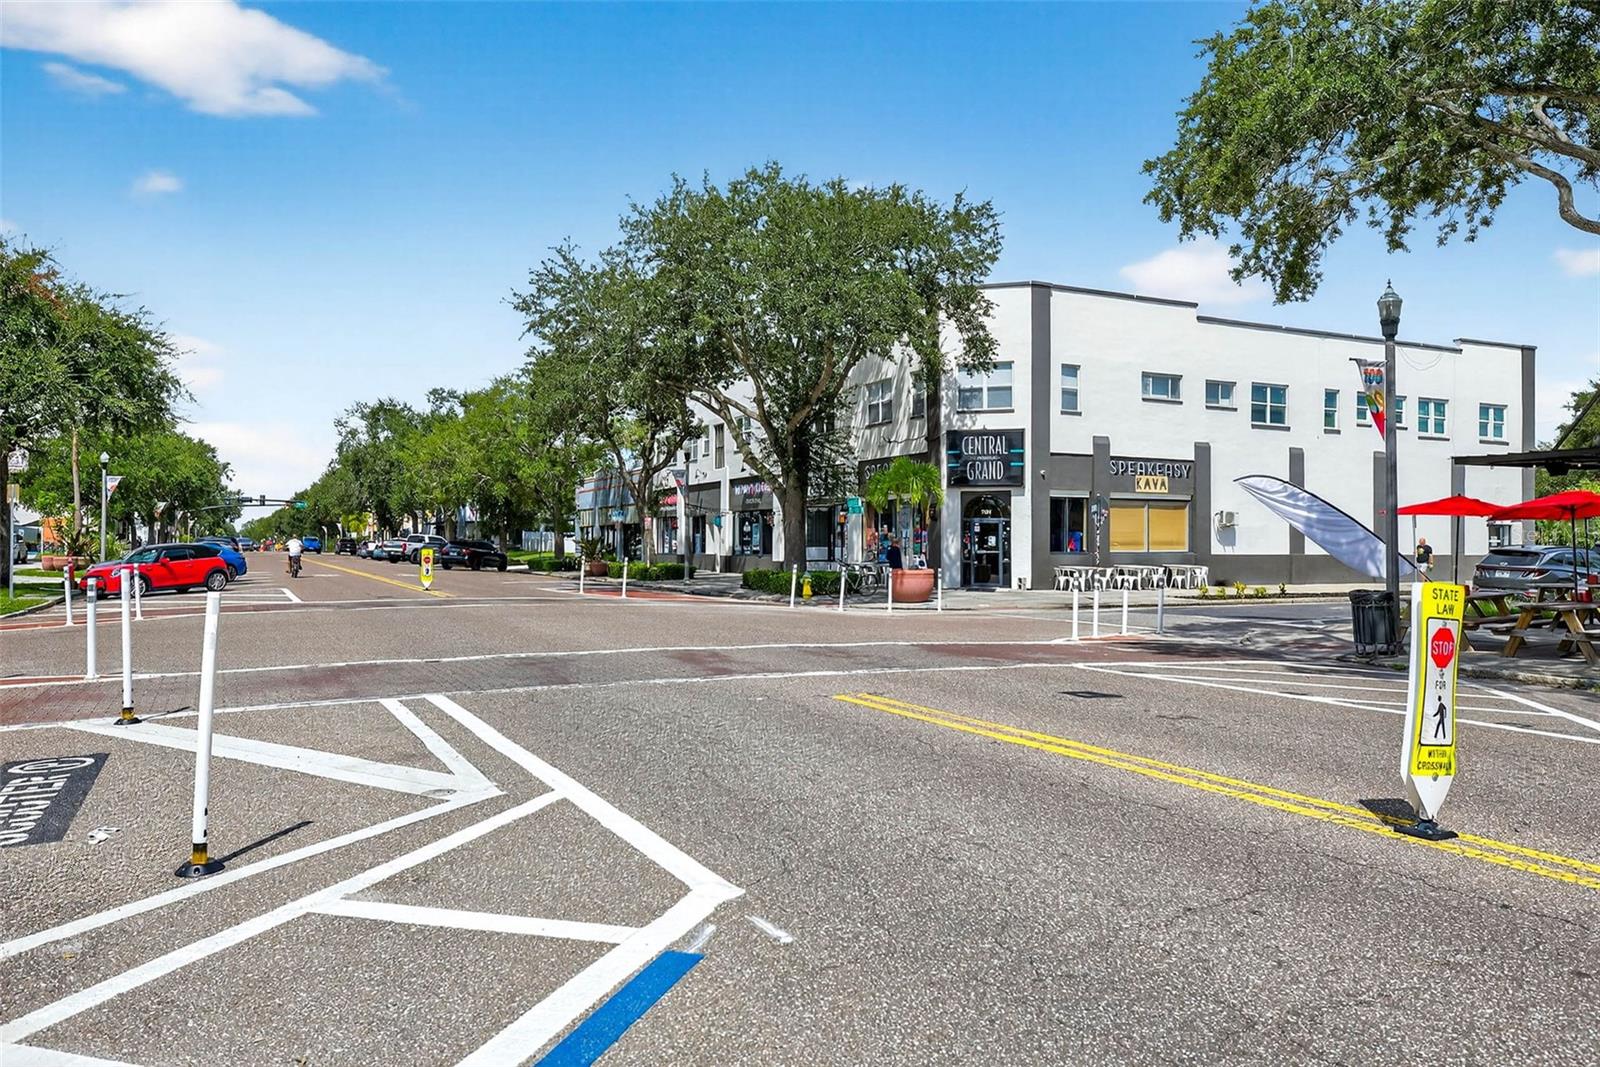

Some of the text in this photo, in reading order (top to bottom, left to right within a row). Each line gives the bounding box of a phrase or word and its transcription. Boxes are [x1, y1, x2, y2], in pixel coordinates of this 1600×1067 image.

[961, 435, 1009, 455] CENTRAL
[966, 460, 1004, 481] GRAND
[1109, 460, 1191, 479] SPEAKEASY
[1432, 587, 1459, 602] STATE
[1436, 603, 1455, 616] LAW
[1432, 640, 1454, 656] STOP
[1434, 679, 1447, 690] FOR
